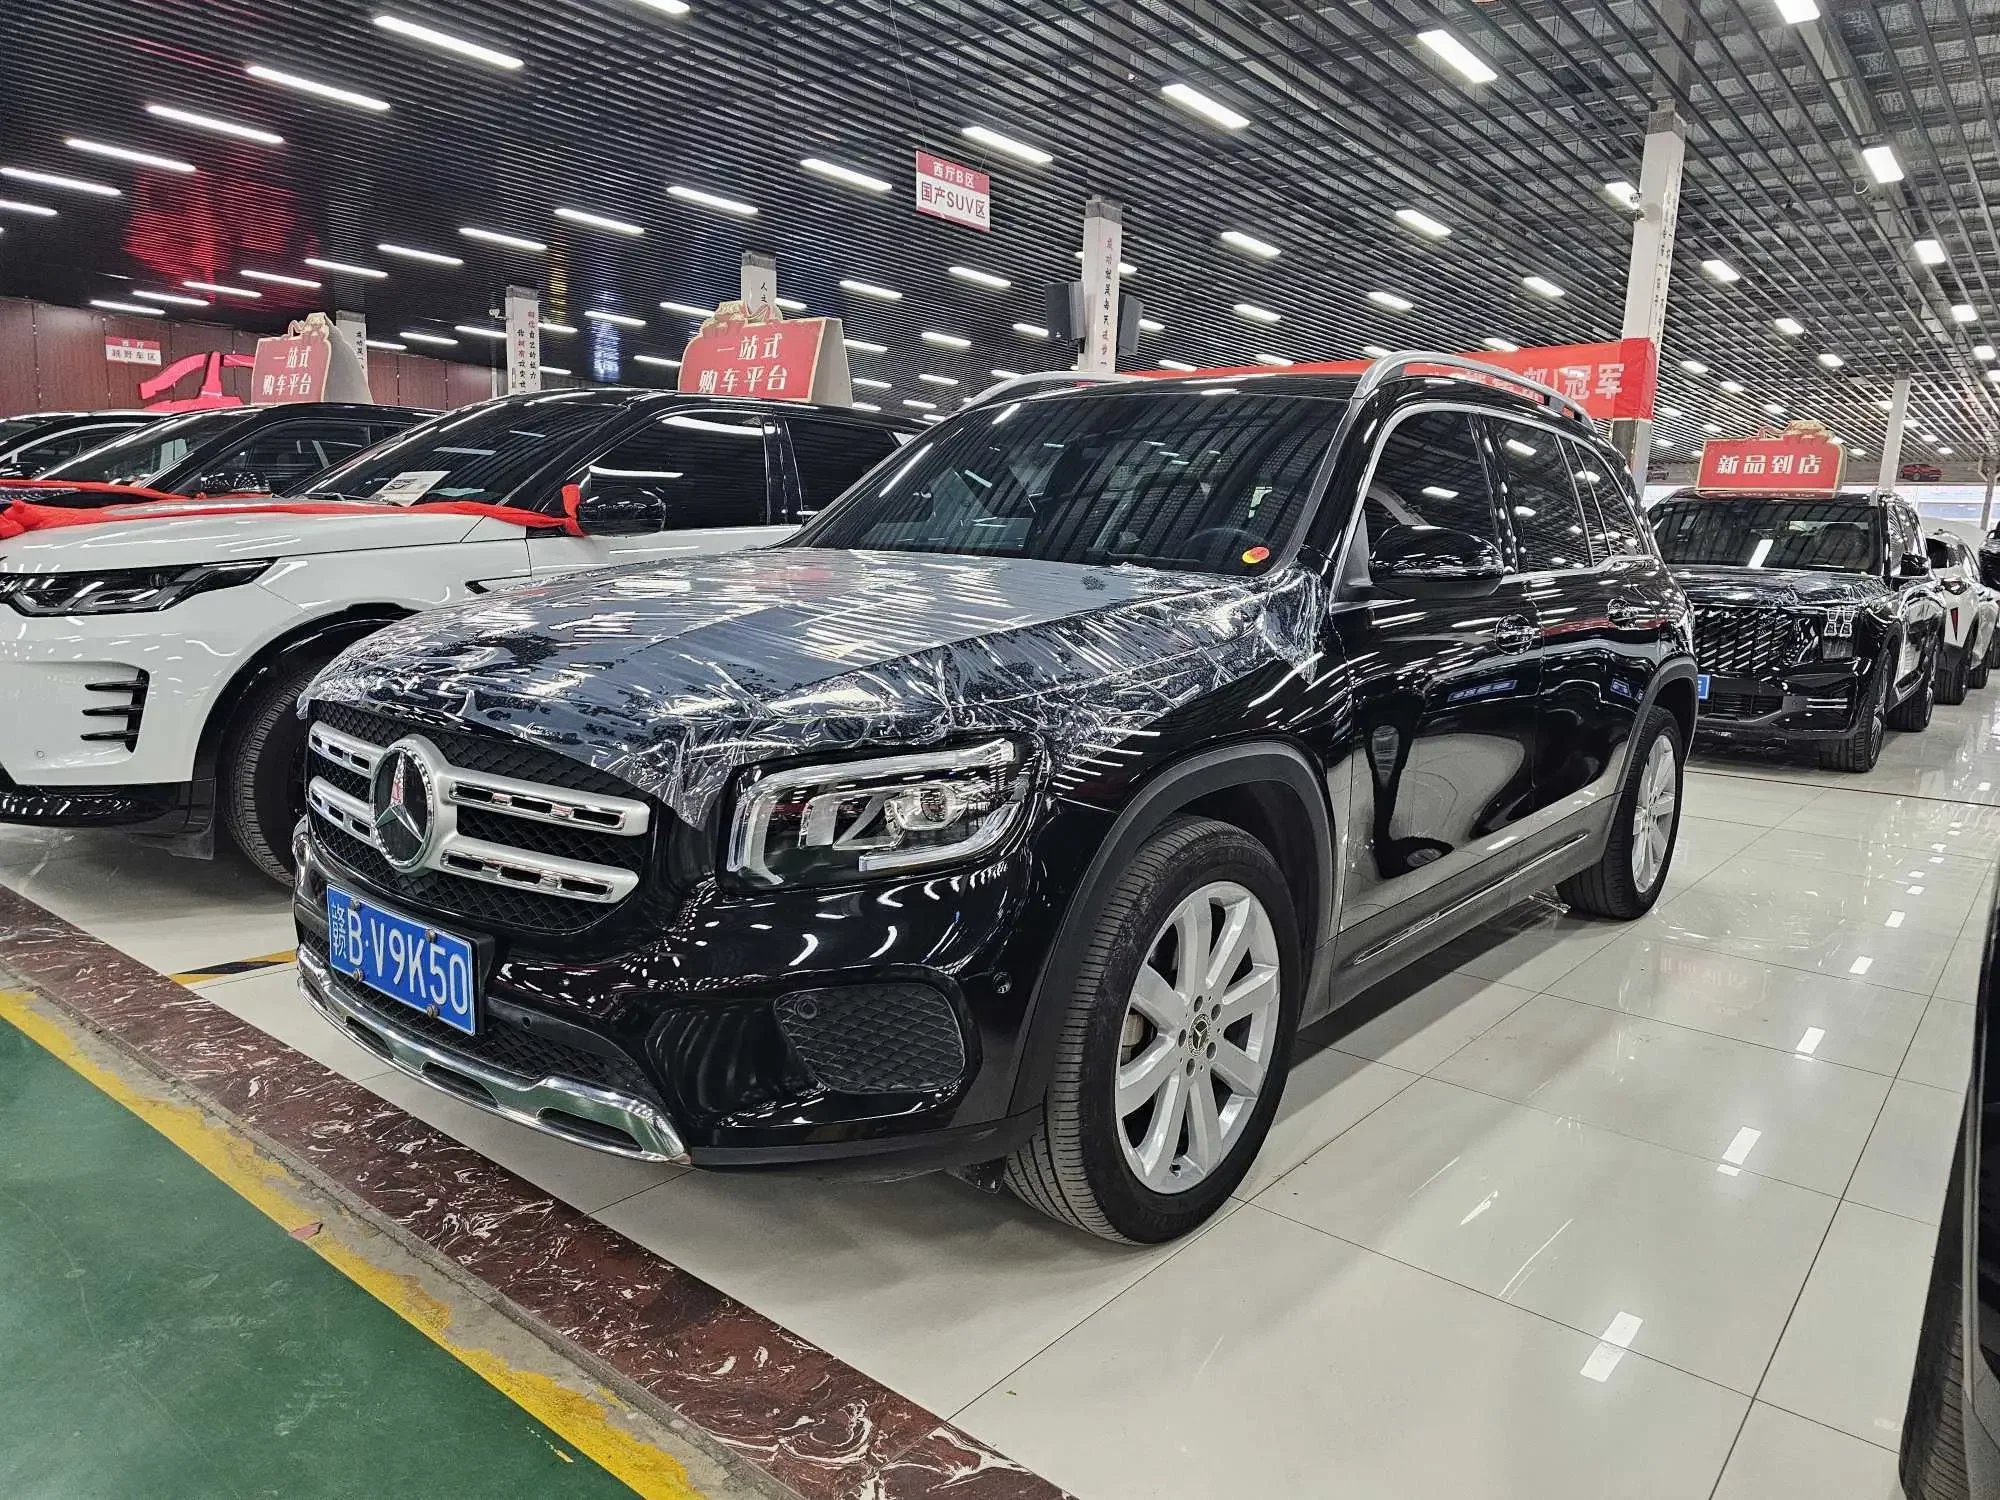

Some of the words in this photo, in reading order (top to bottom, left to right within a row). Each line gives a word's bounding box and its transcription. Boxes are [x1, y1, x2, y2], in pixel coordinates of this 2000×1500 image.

[933, 161, 975, 188] 西厅B区
[922, 181, 986, 219] 国产SUV区
[273, 345, 312, 368] 一站式
[717, 333, 782, 360] 一站式
[262, 372, 312, 396] 购车平台
[698, 364, 787, 394] 购车平台
[1716, 454, 1822, 475] 新品到店
